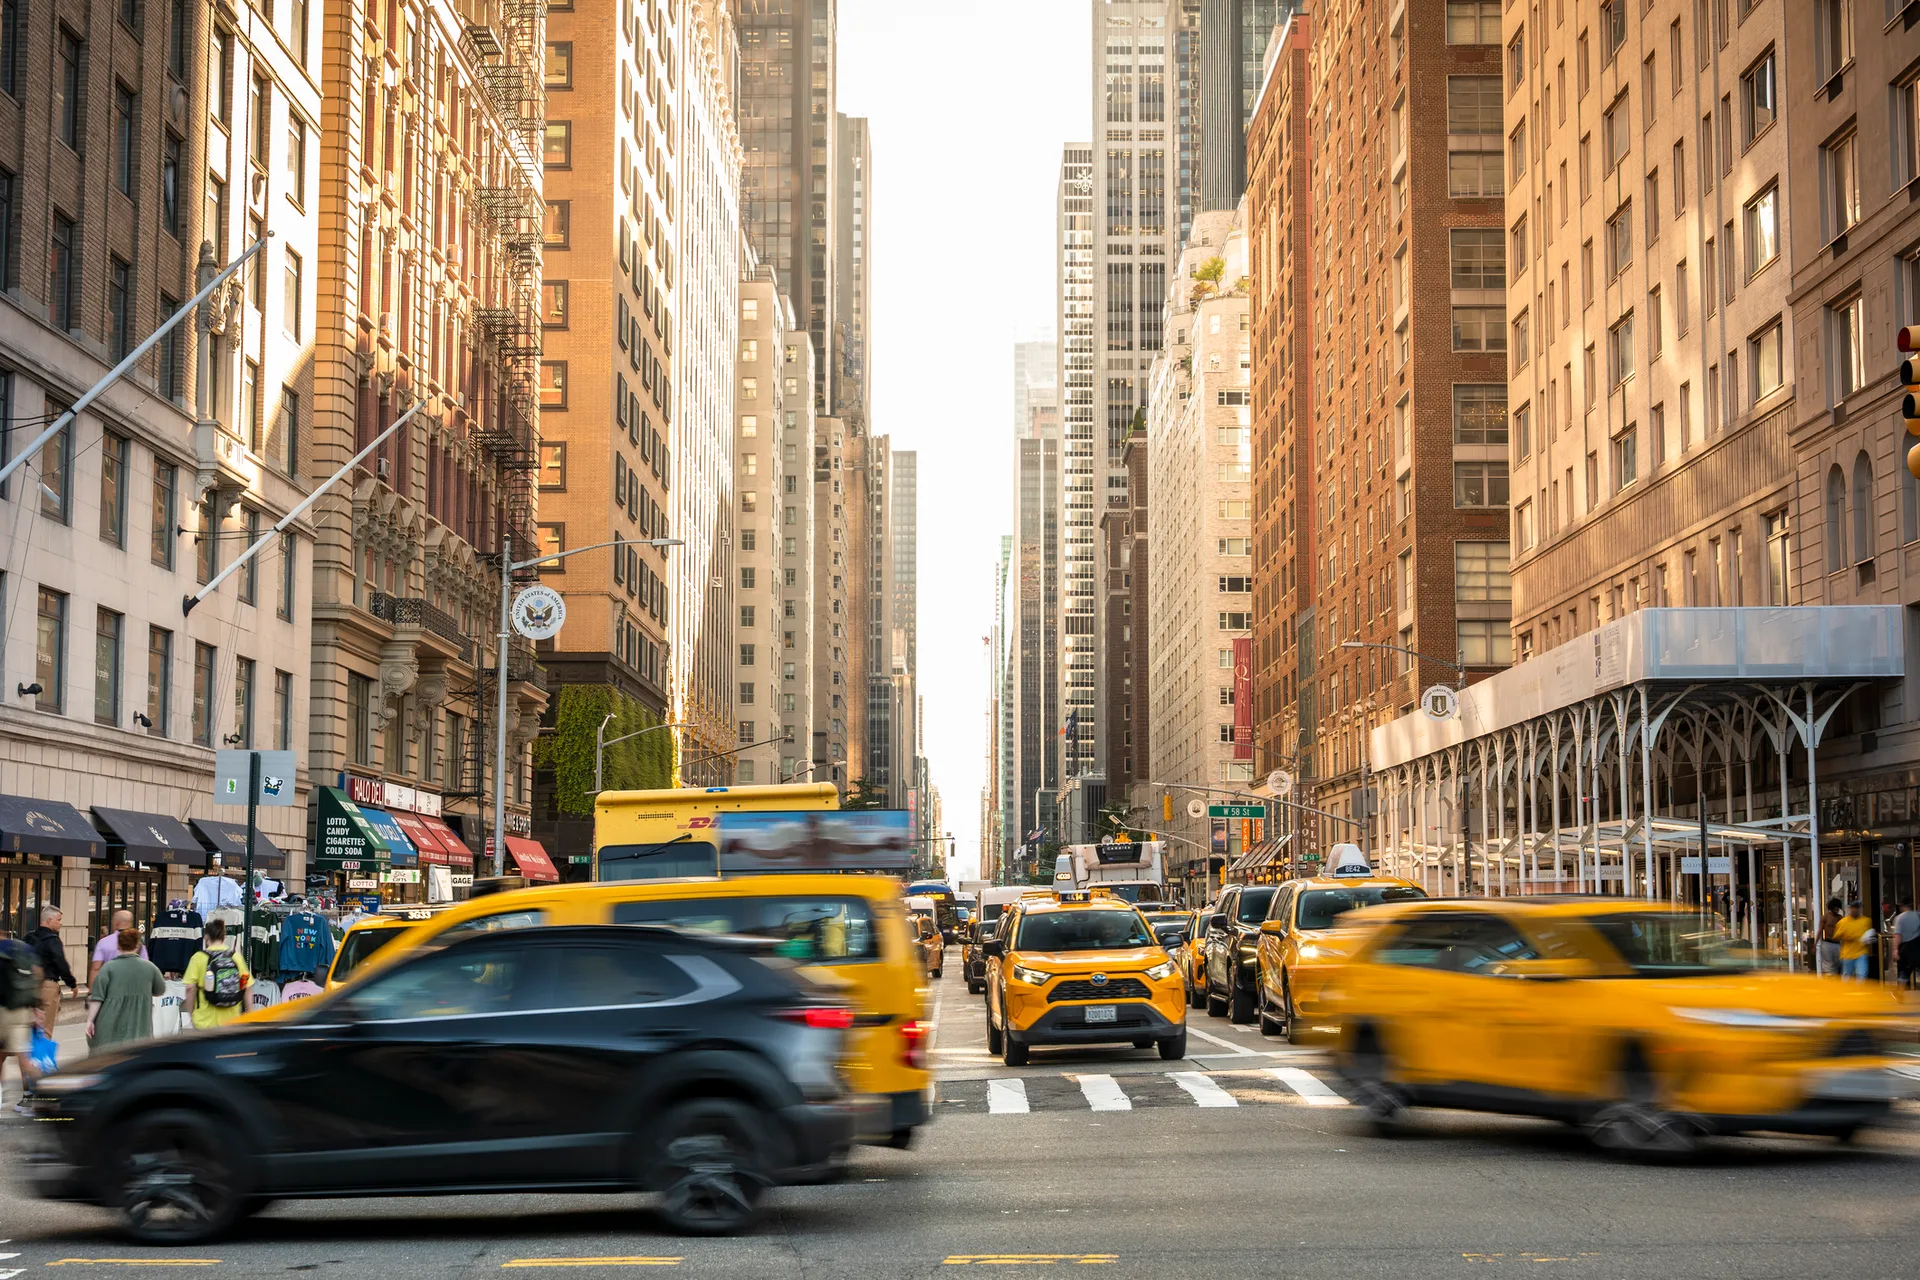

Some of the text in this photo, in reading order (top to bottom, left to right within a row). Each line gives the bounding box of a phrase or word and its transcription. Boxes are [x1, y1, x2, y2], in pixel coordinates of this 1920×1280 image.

[515, 599, 525, 620] UNITED
[524, 590, 544, 599] STATES
[550, 595, 563, 620] AMERICA
[354, 778, 385, 805] HALO DELI
[1223, 807, 1250, 816] W 58 St
[326, 817, 347, 826] LOTTO
[1309, 786, 1317, 850] JEWELR
[326, 827, 350, 836] CANDY
[325, 837, 366, 846] CIGARETTES
[325, 846, 363, 856] COLD SODA
[343, 861, 360, 869] ATM
[161, 996, 175, 1007] NEW
